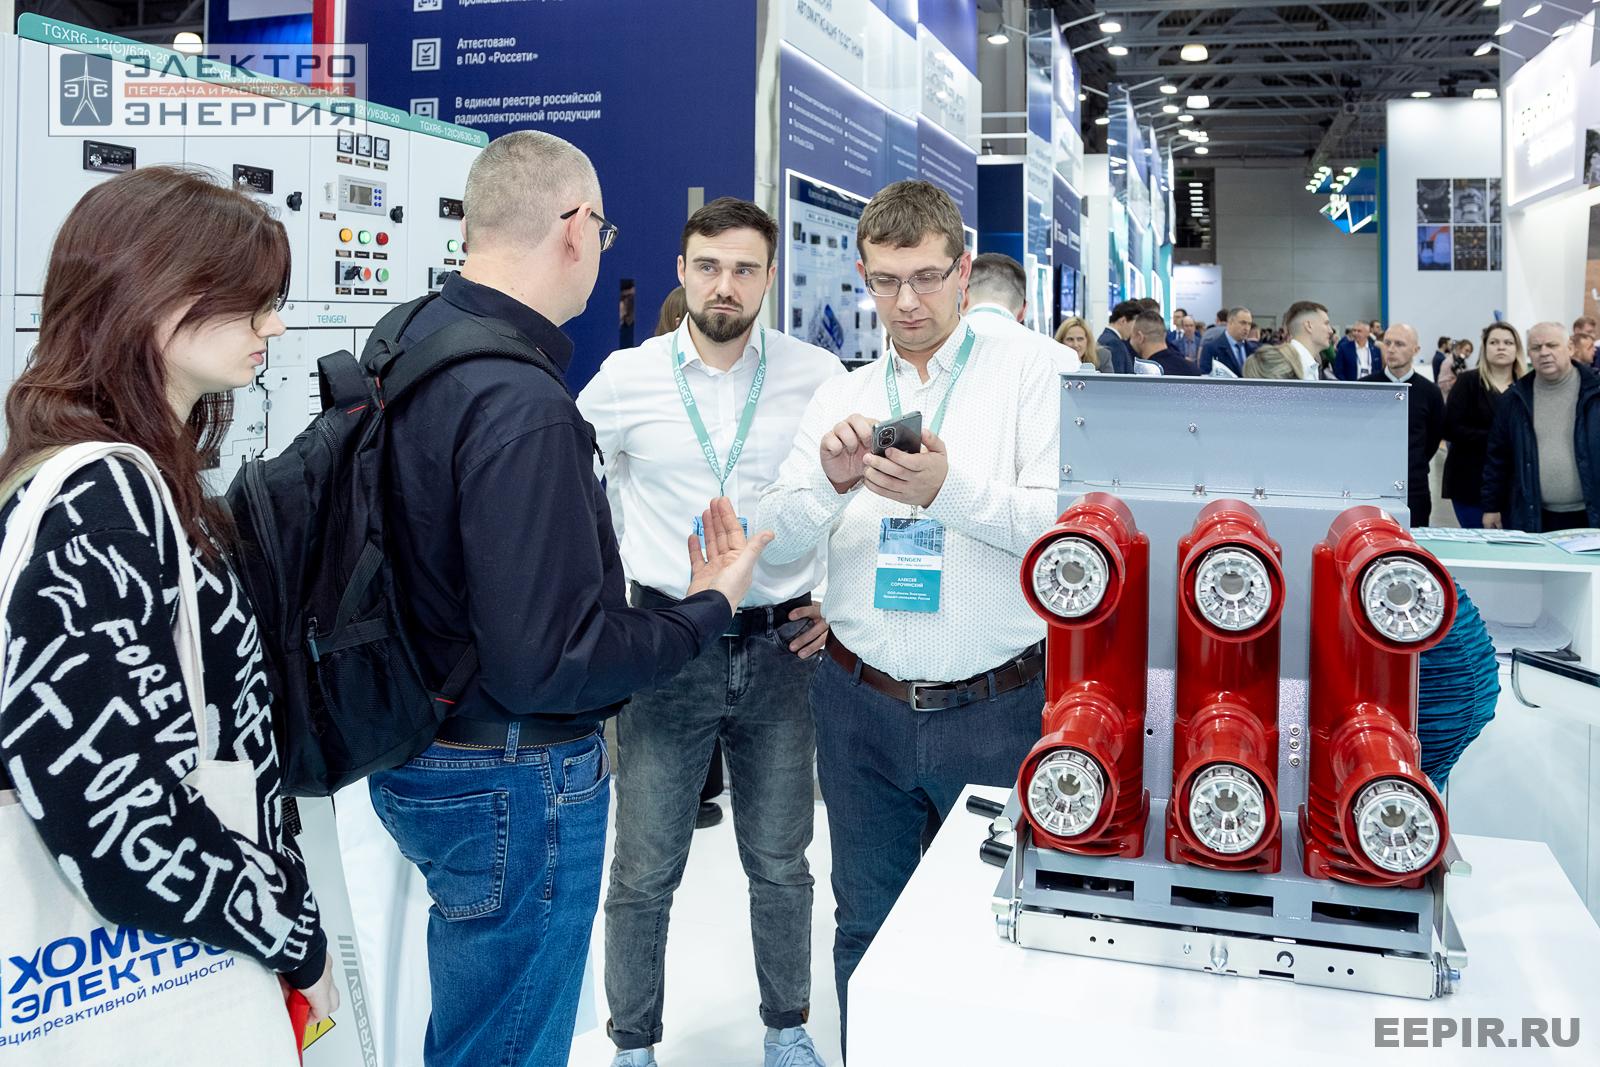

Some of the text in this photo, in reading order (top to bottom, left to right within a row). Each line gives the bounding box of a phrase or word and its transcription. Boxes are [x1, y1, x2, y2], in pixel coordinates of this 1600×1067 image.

[456, 37, 516, 49] Аттестовано
[456, 52, 539, 65] в ПАО «Россети»
[455, 91, 602, 109] В едином реестре российской
[454, 109, 601, 125] радиоэлектронной продукции
[317, 314, 347, 324] TENGEN
[672, 365, 694, 407] TENGEN
[748, 362, 766, 405] TENGEN
[702, 440, 721, 474] TENG
[48, 697, 233, 923] FORGET
[43, 986, 147, 1036] реактивной
[151, 957, 235, 995] мощности
